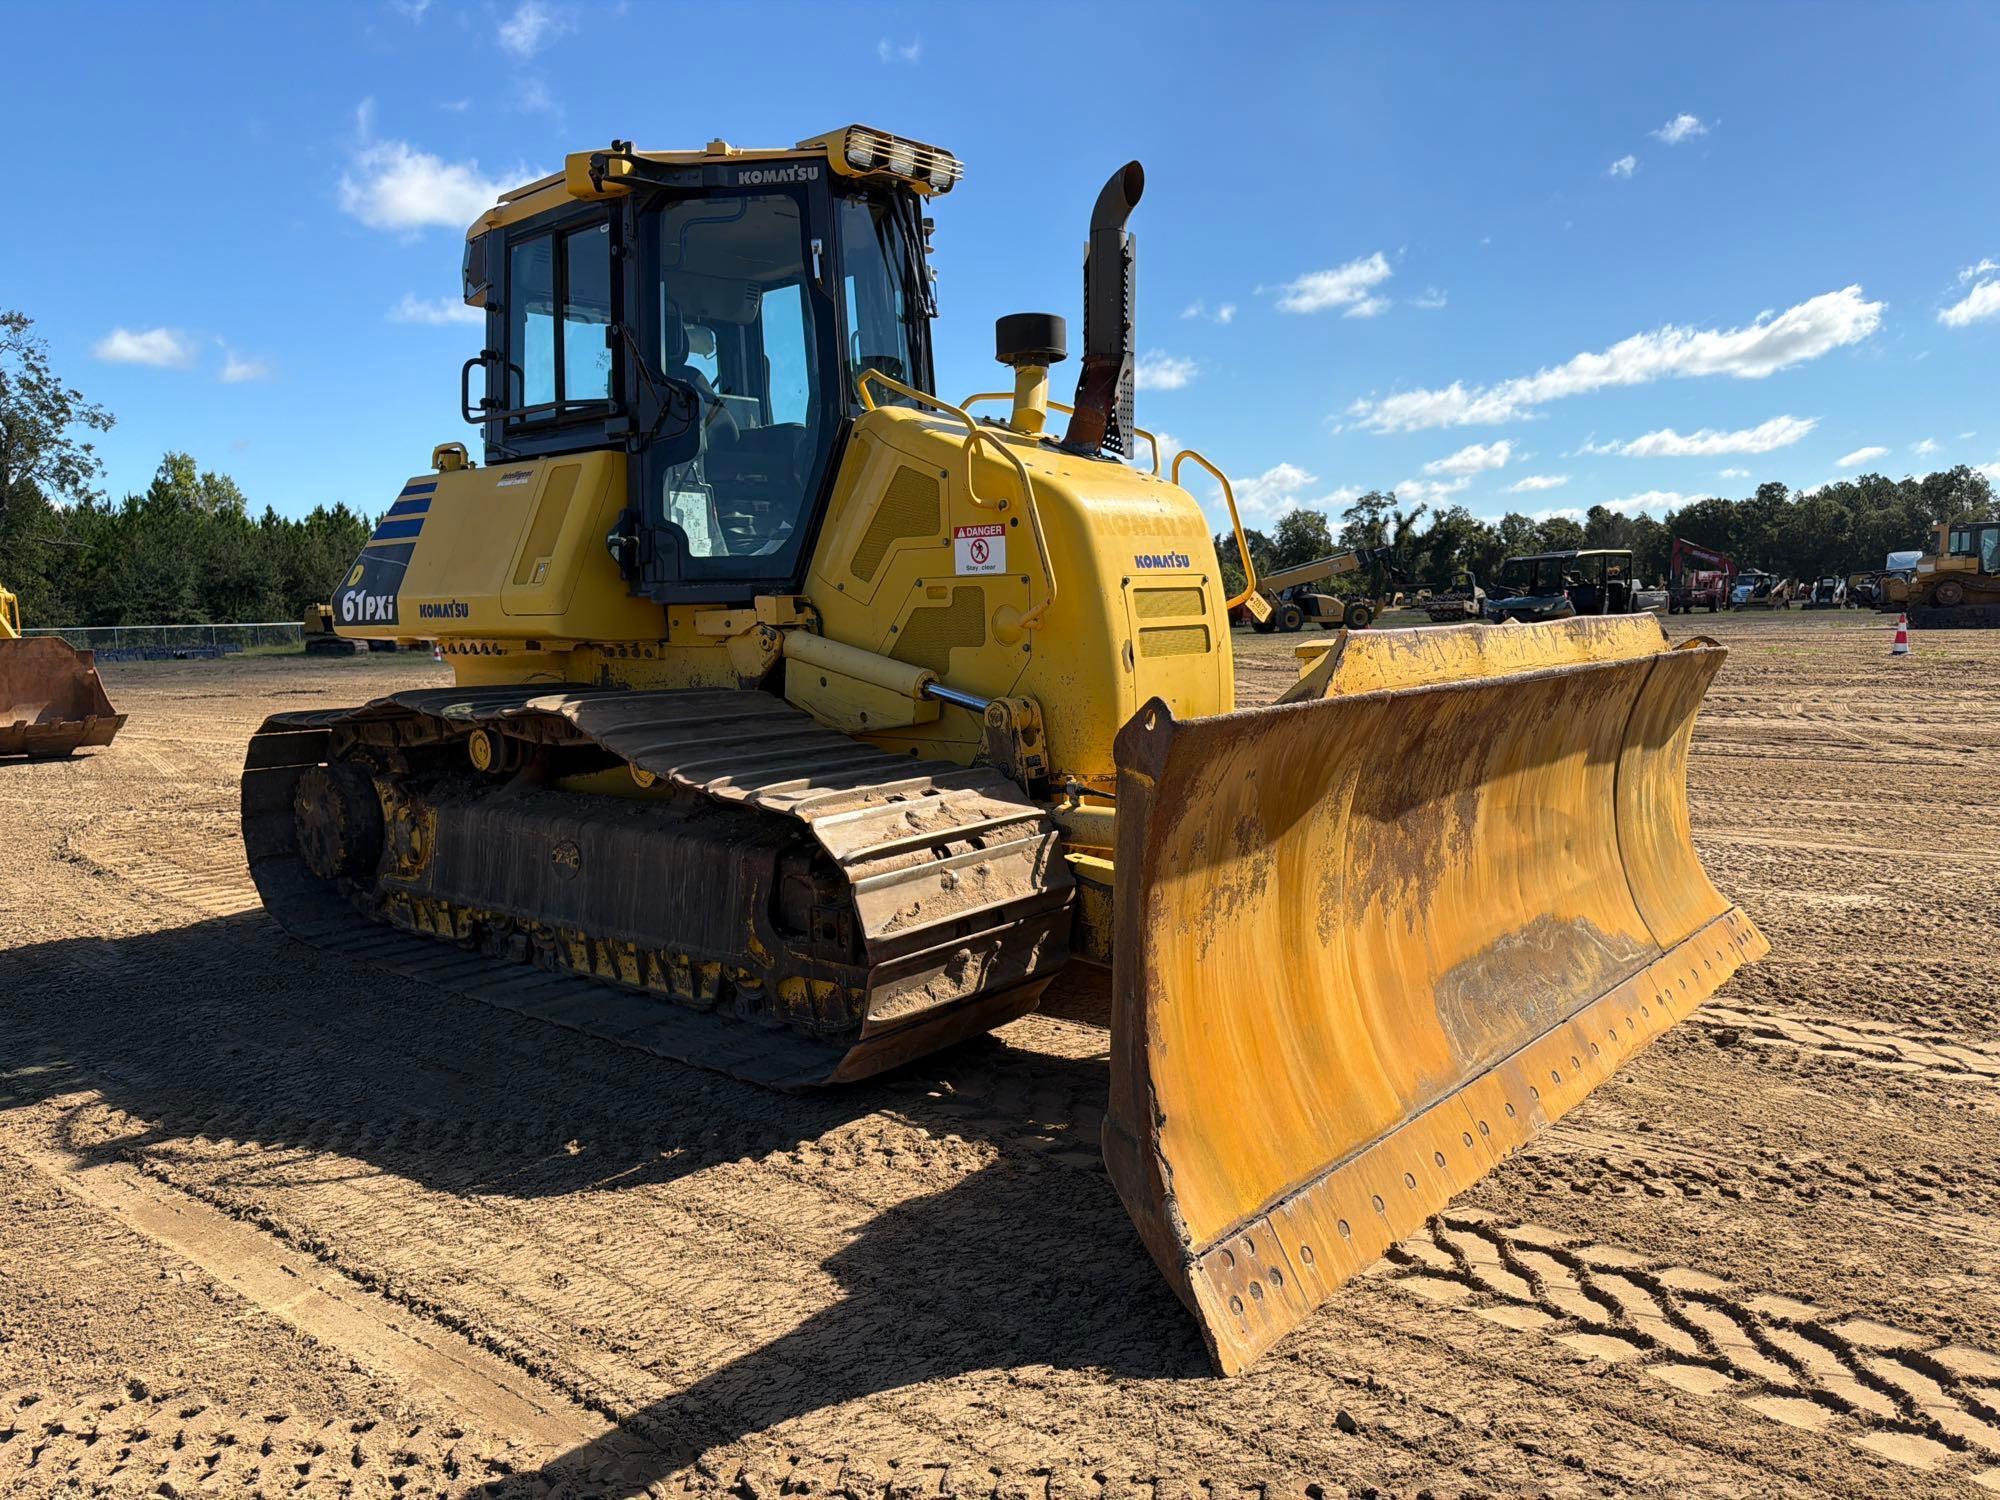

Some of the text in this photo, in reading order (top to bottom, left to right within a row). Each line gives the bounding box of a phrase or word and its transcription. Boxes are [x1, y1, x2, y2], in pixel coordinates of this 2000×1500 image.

[738, 164, 819, 185] KOMATSU
[966, 525, 1002, 537] DANGER
[966, 564, 979, 572] Stay
[1134, 551, 1190, 568] KOMATSU
[347, 564, 364, 587] D
[342, 590, 394, 622] 61PXi
[419, 599, 469, 618] KOMATSU
